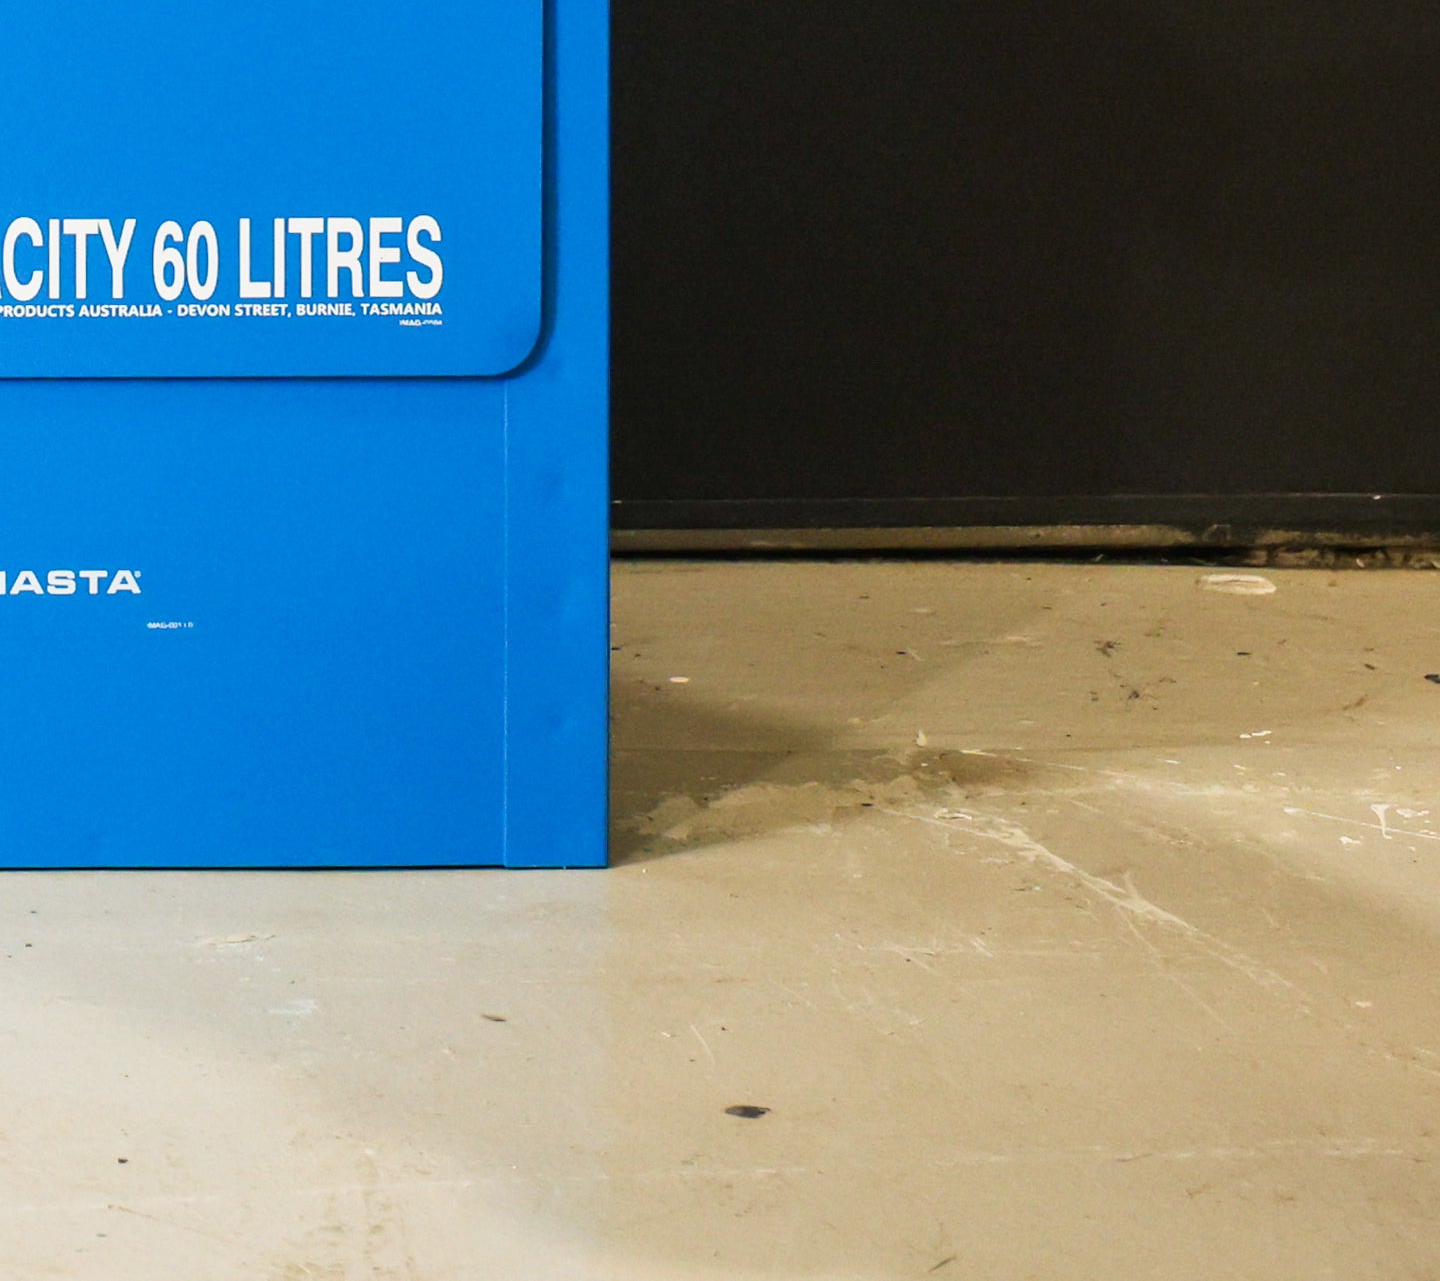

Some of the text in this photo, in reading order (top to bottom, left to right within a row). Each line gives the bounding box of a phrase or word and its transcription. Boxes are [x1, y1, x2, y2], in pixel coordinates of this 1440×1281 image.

[153, 220, 219, 301] 60
[239, 214, 443, 300] LITRES
[78, 304, 163, 317] AUSTRALIA
[177, 304, 231, 317] DEVON
[234, 304, 292, 319] STREET,
[361, 302, 443, 316] TASMANIA
